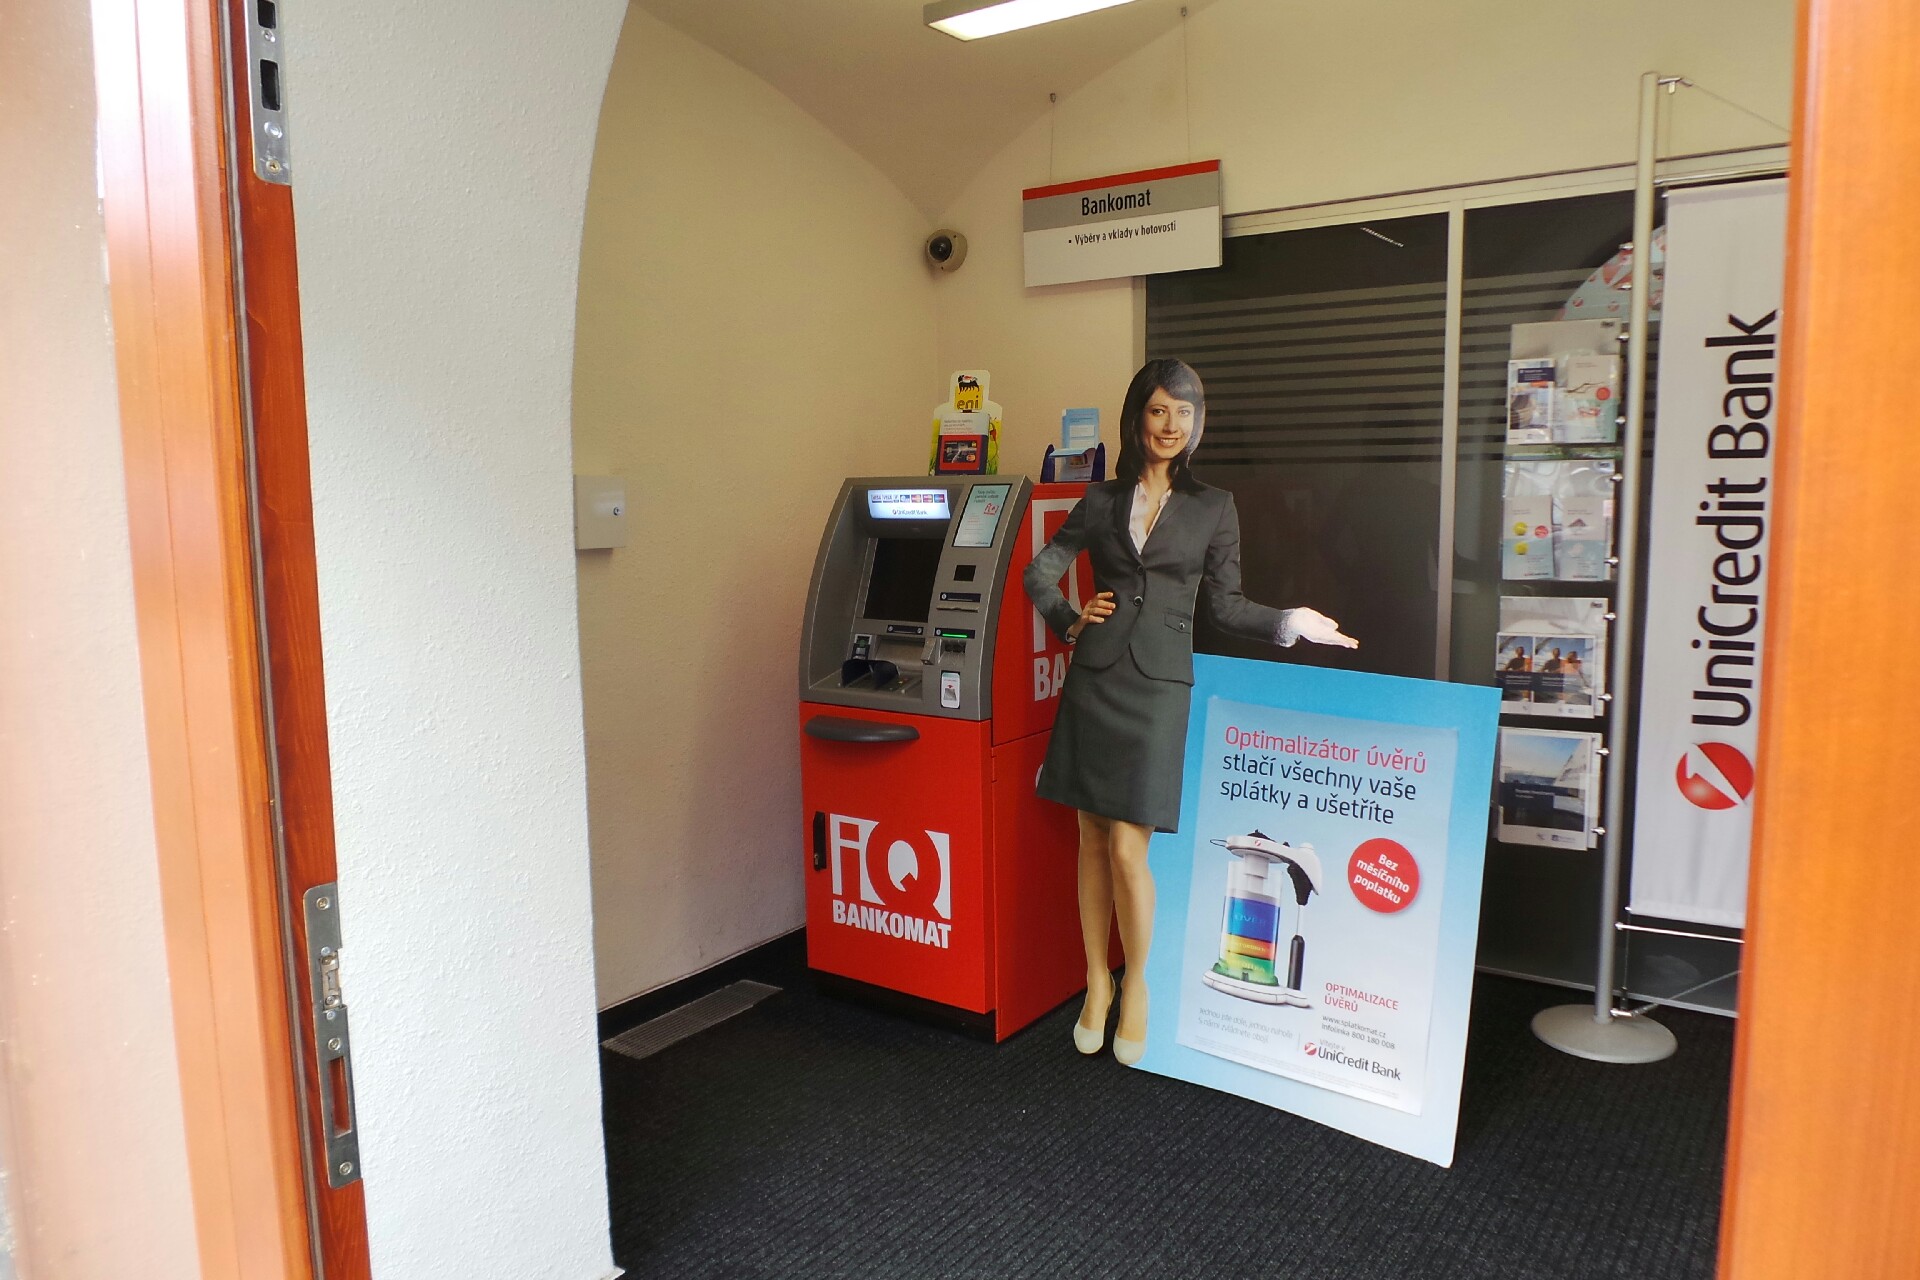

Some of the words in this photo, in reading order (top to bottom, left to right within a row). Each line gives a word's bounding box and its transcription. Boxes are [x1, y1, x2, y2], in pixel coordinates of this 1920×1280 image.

[1081, 188, 1151, 216] Bankomat
[1075, 231, 1100, 246] Výběry
[1102, 233, 1107, 241] a
[1108, 227, 1133, 241] vklady
[1134, 228, 1139, 237] v
[1705, 308, 1779, 460] Bank
[956, 394, 979, 411] eni
[1692, 476, 1767, 727] UniCredit
[1224, 726, 1361, 763] Optimalizátor
[1366, 746, 1427, 774] úvěrů
[1222, 753, 1277, 776] stlačí
[1280, 760, 1363, 796] všechny
[1369, 776, 1417, 801] vaše
[1219, 779, 1291, 810] splátky
[1297, 793, 1308, 809] a
[1316, 793, 1395, 825] ušetříte
[1356, 859, 1410, 893] měsíčního
[1378, 853, 1399, 871] Bez
[1353, 874, 1401, 904] poplatku
[832, 899, 953, 949] BANKOMAT
[1324, 993, 1358, 1012] ÚVĚRŮ
[1325, 982, 1399, 1011] OPTIMALIZACE
[1322, 1015, 1386, 1038] www.splatkomat.cz
[1351, 1031, 1365, 1041] 800
[1367, 1036, 1380, 1045] 180
[1381, 1040, 1396, 1050] 008
[1317, 1046, 1369, 1071] UniCredit
[1371, 1061, 1401, 1081] Bank
